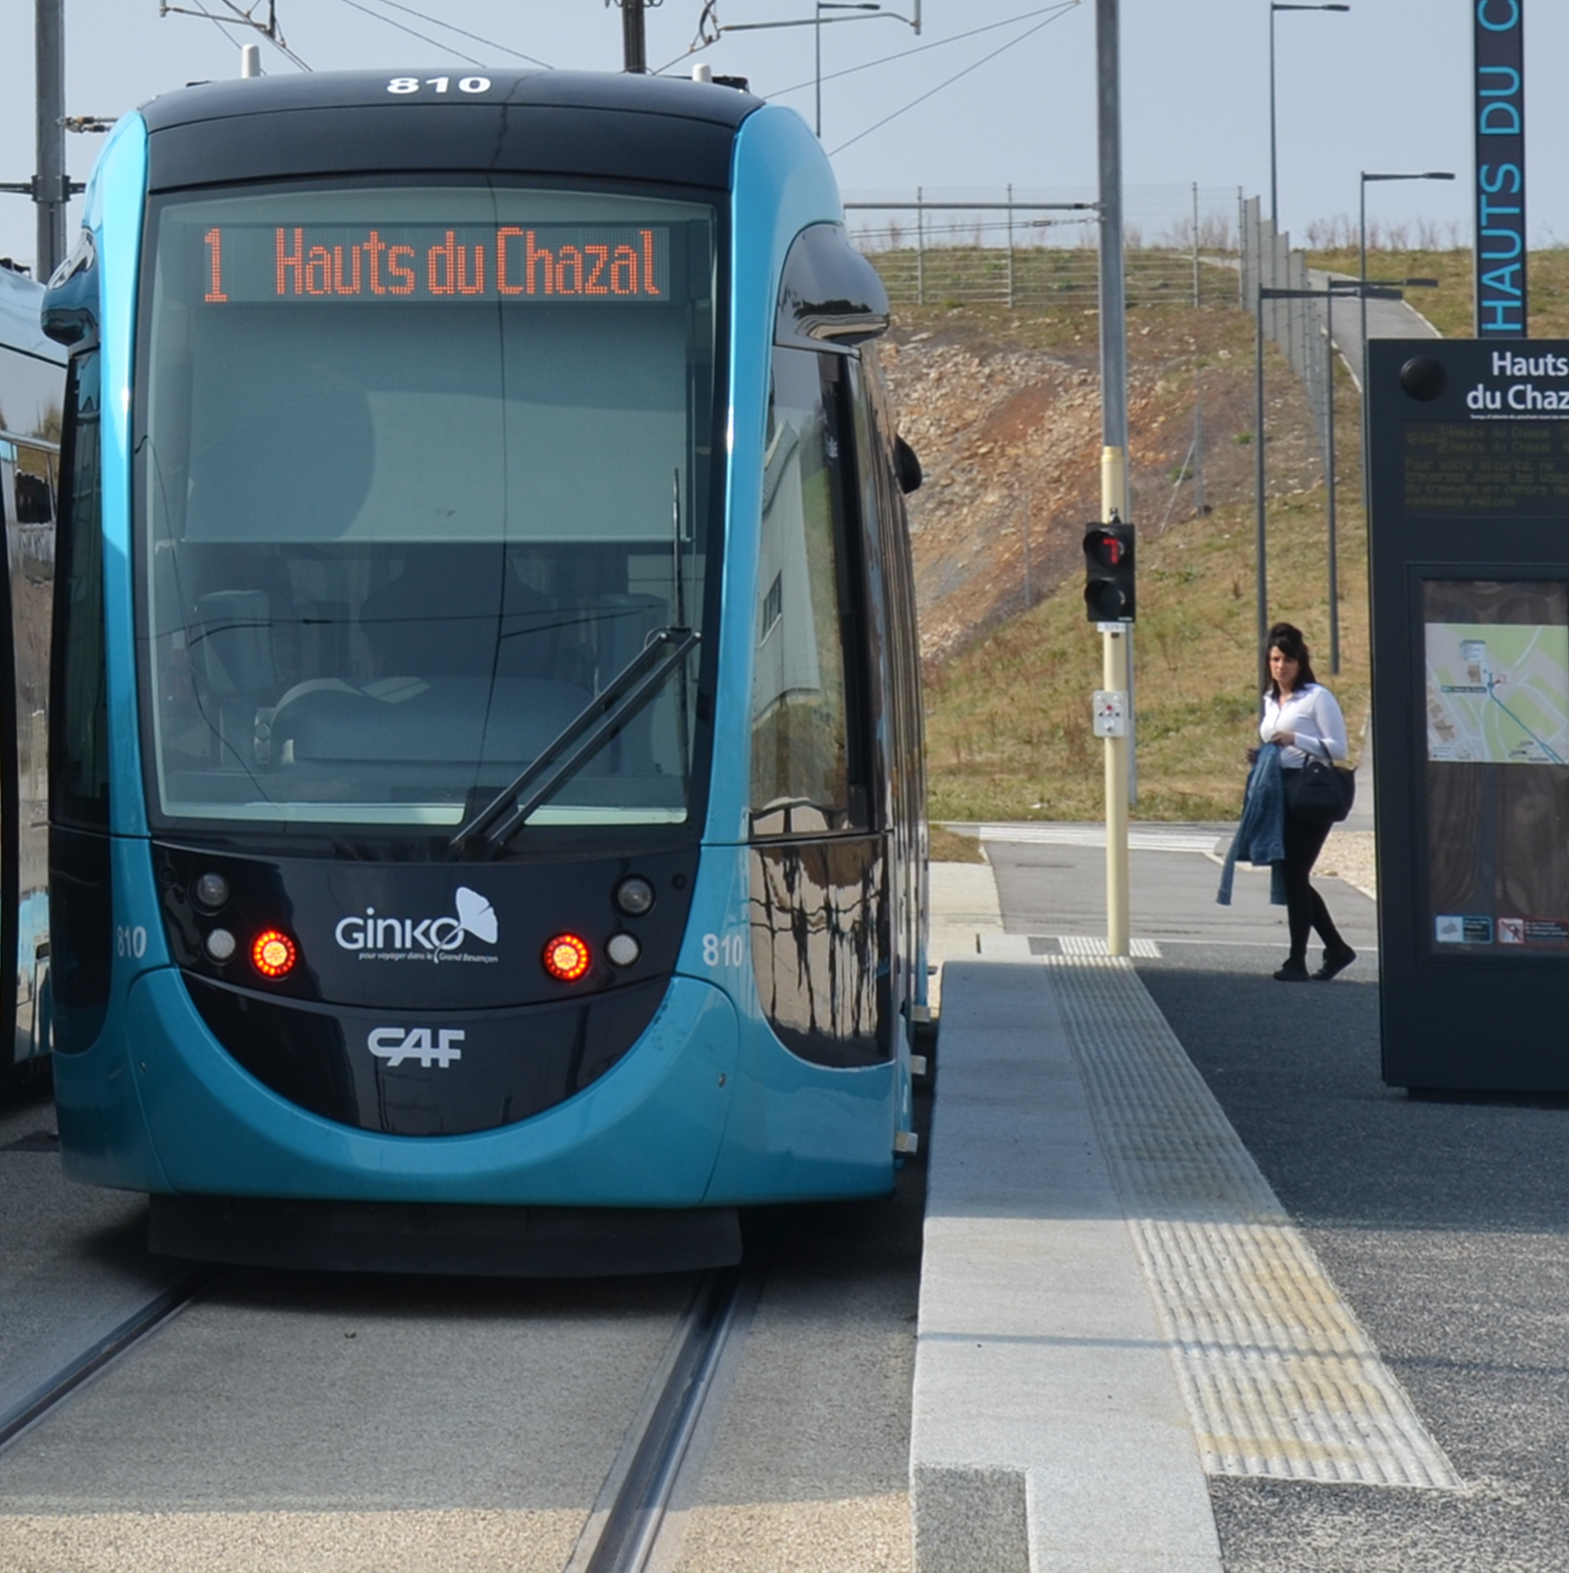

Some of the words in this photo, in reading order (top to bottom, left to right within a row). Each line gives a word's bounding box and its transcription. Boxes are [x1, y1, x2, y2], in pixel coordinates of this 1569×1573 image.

[386, 76, 493, 94] 810
[1478, 65, 1522, 136] DU
[1479, 162, 1523, 332] HAUTS
[203, 228, 228, 304] 1
[274, 228, 415, 296] Hauts
[426, 230, 485, 296] du
[495, 227, 661, 297] Chazal
[1492, 351, 1569, 377] Hauts
[1466, 383, 1502, 410] du
[116, 924, 148, 959] 810
[702, 932, 744, 967] 810
[366, 1027, 466, 1069] CAF
